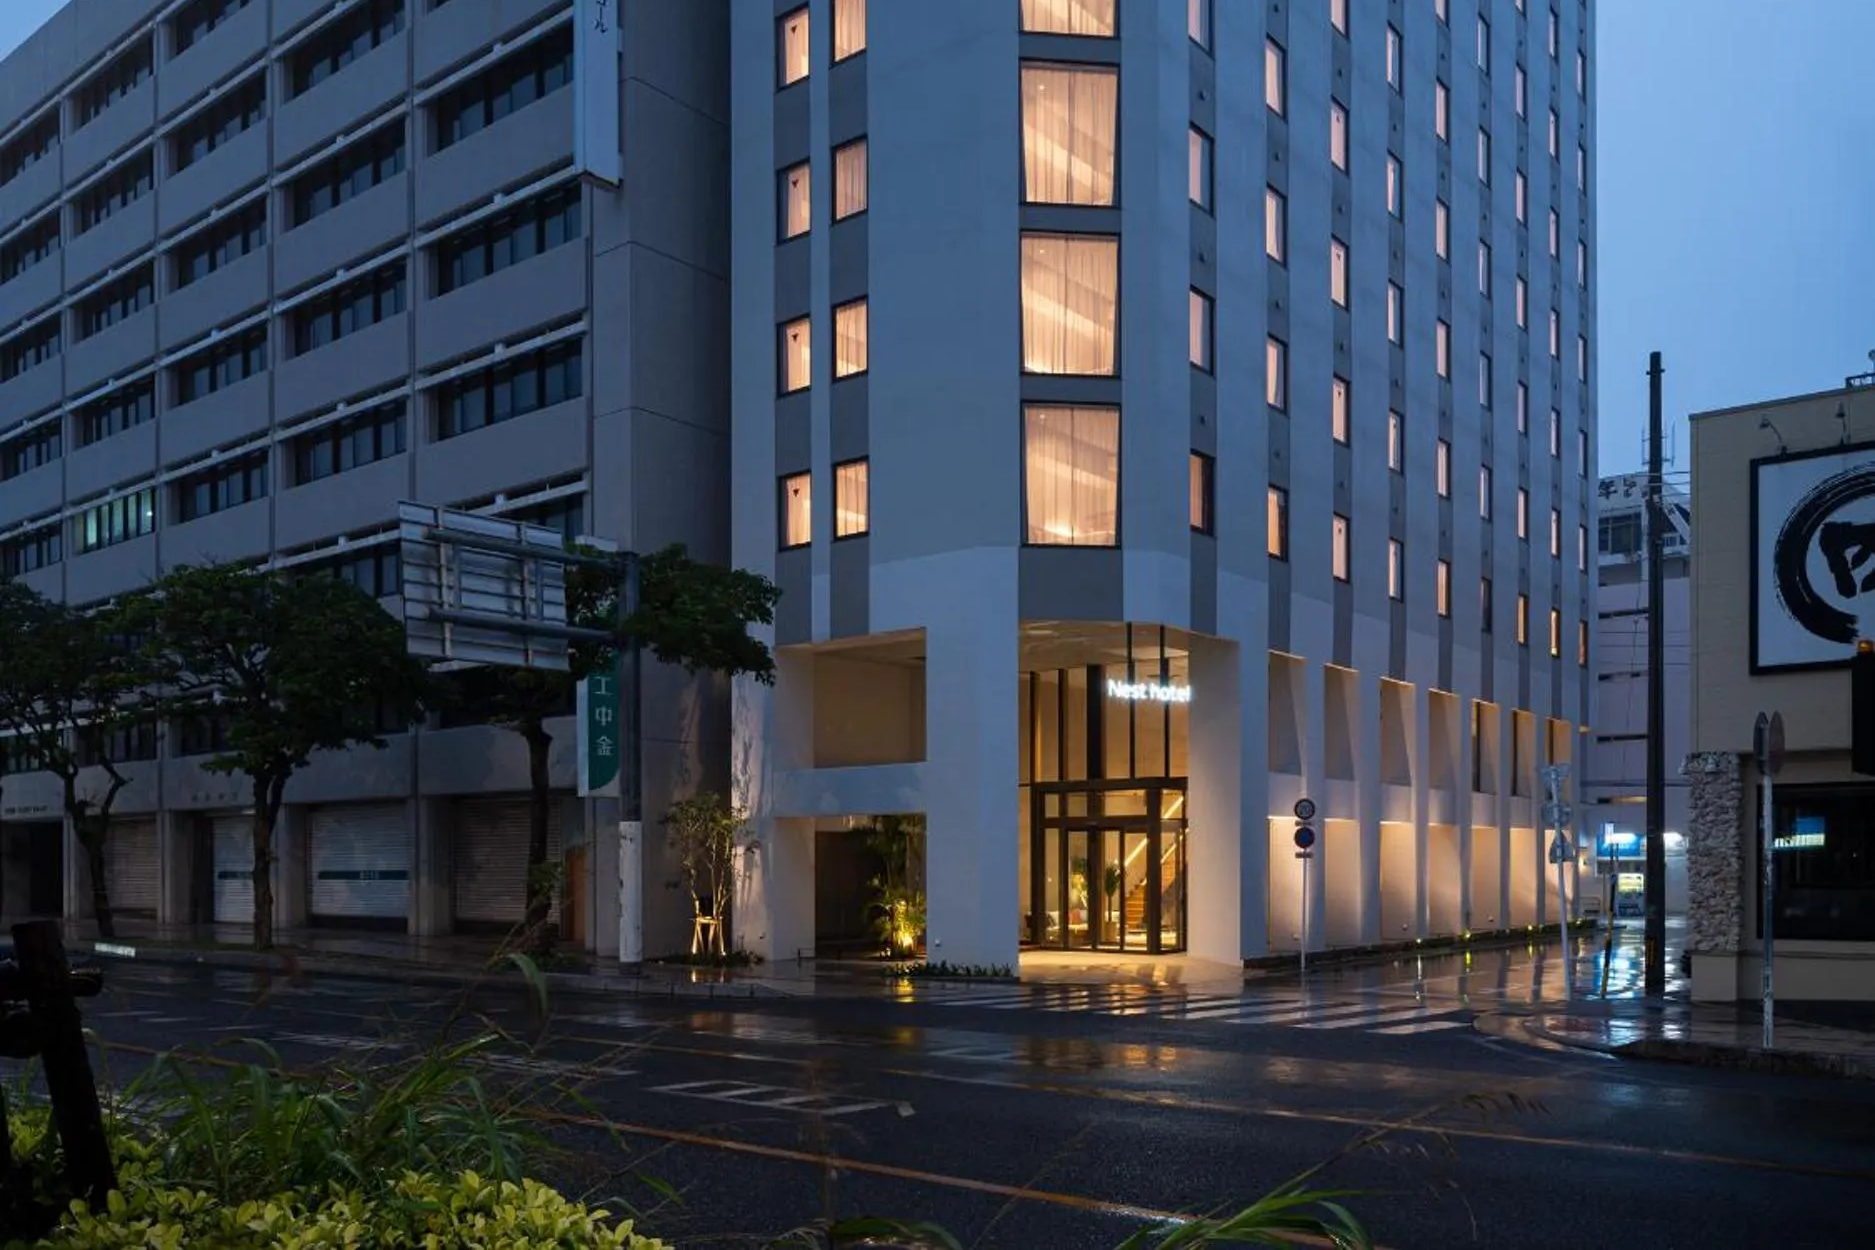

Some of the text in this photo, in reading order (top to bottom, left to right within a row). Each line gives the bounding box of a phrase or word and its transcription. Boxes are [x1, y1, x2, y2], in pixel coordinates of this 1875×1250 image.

[593, 676, 615, 756] 工中金
[1107, 679, 1192, 703] Nest hotel
